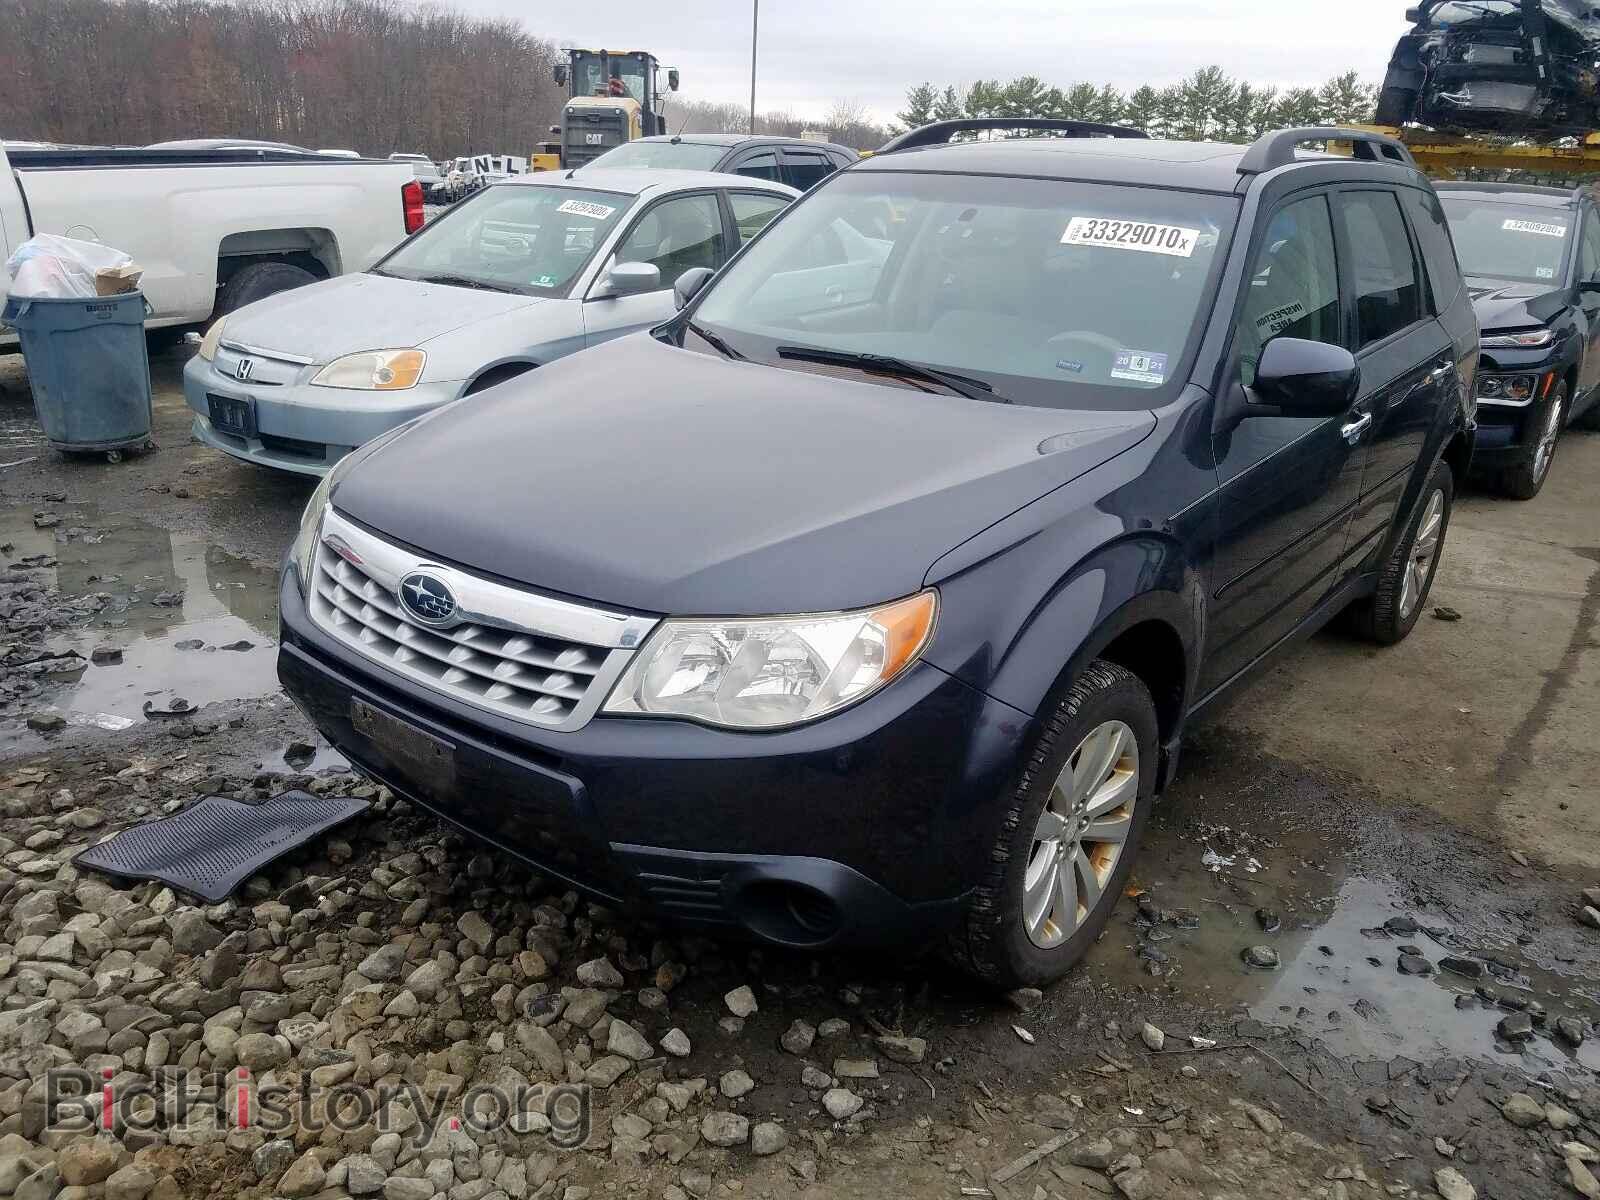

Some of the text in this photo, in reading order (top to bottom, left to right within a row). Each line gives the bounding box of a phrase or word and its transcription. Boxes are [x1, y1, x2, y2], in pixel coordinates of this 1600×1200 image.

[585, 133, 603, 145] CAT
[475, 157, 489, 175] N
[506, 158, 519, 174] L
